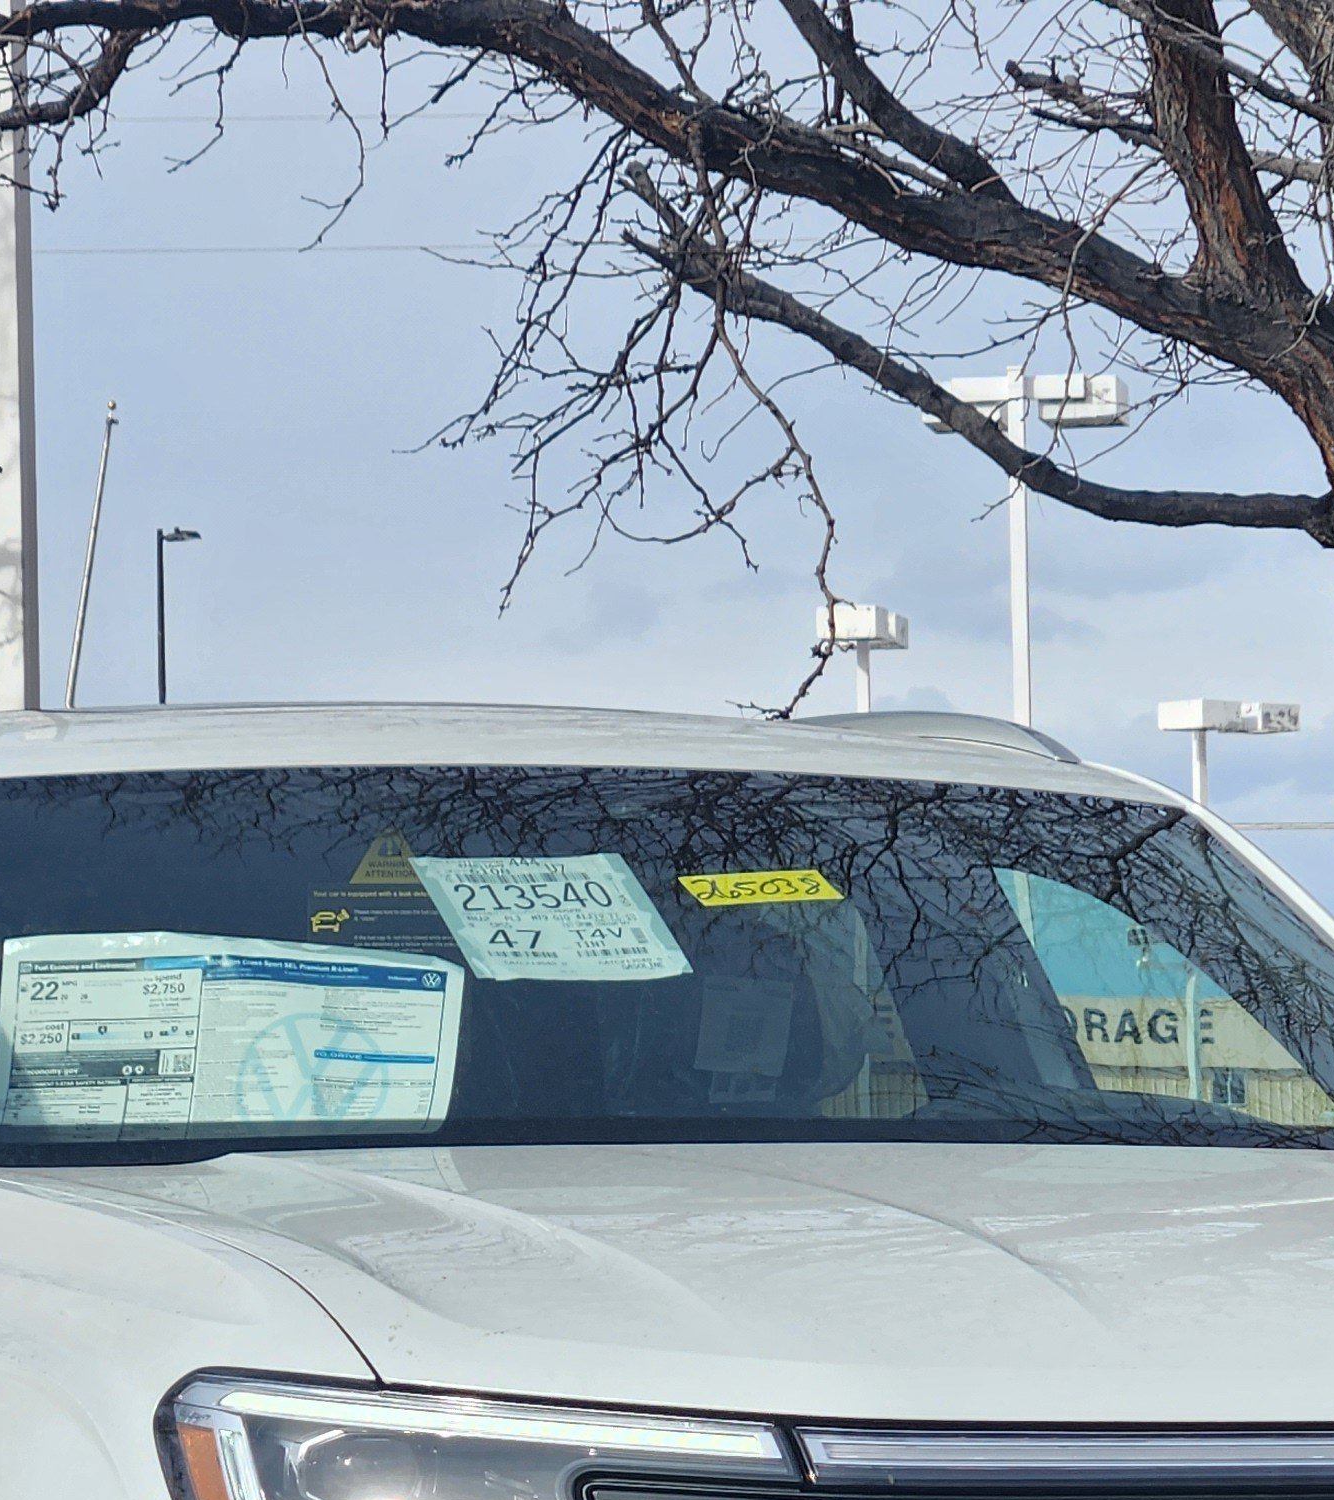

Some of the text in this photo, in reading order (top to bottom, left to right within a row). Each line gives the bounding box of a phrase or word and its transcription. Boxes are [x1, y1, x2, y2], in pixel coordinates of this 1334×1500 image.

[453, 881, 613, 912] 213540
[488, 927, 622, 949] 47 T4V
[30, 981, 59, 1001] 22
